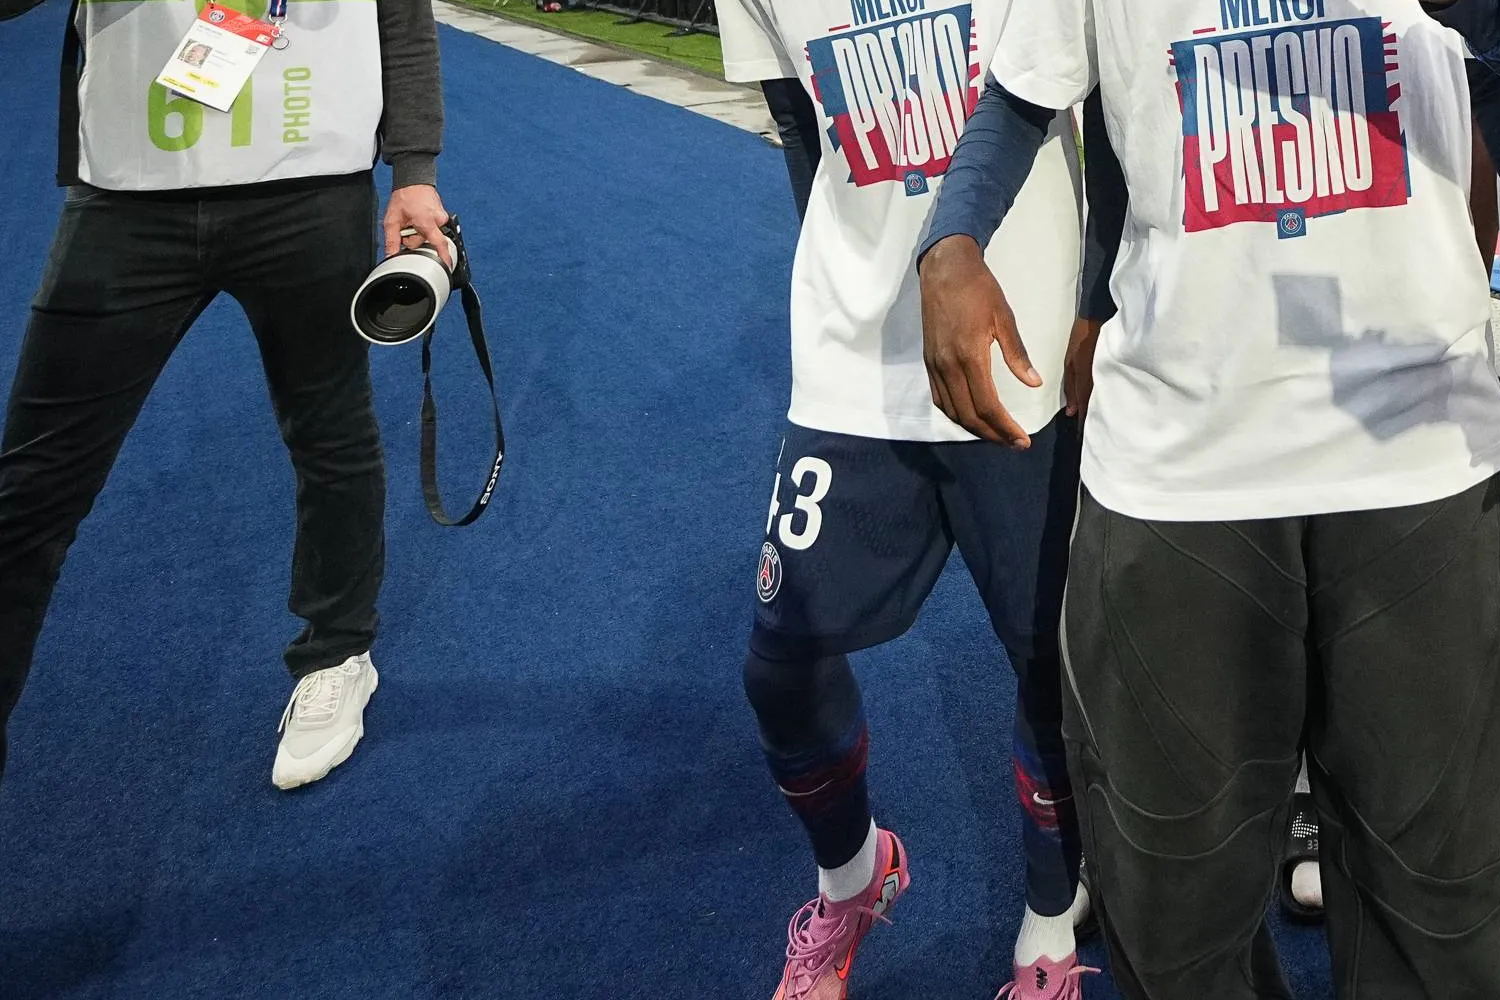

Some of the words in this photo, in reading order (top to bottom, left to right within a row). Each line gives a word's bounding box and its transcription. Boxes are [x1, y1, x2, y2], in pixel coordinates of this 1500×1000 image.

[282, 67, 312, 144] PHOTO
[1194, 24, 1373, 213] PRESKO
[480, 450, 503, 504] SONY
